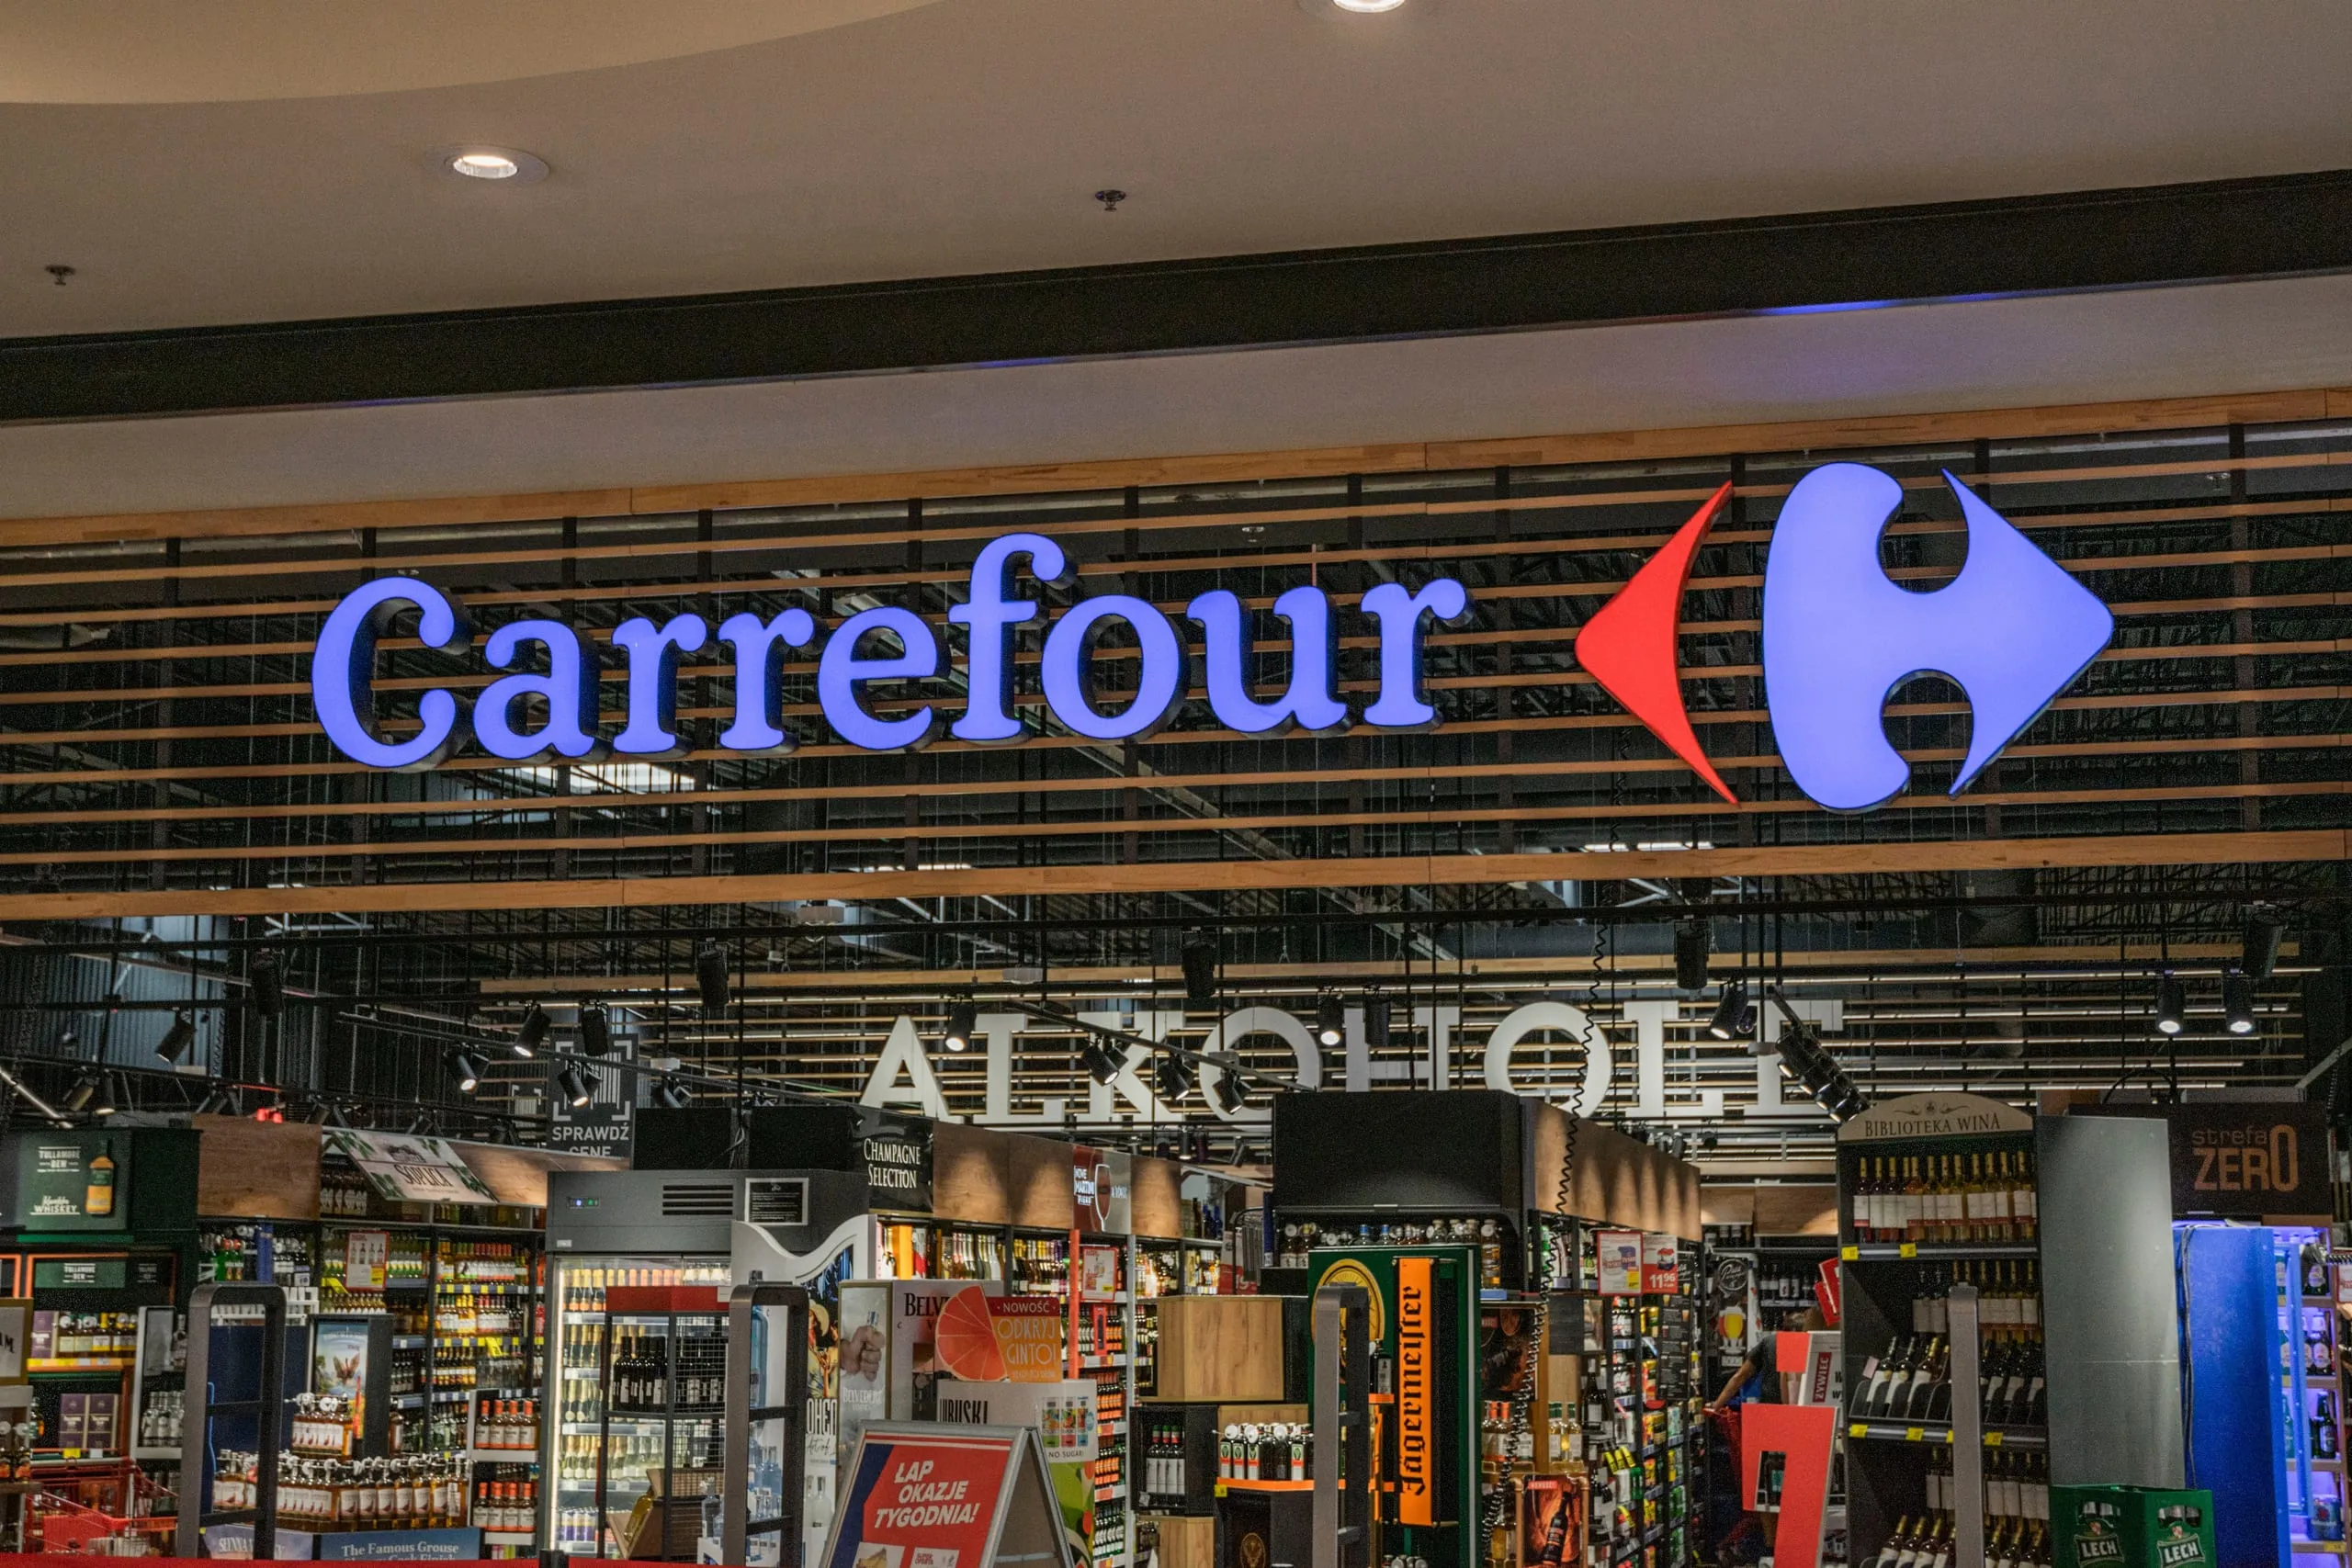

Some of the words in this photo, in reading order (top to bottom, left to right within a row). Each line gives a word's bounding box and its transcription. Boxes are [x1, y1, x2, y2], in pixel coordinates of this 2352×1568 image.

[311, 531, 1467, 768] Carrefour
[859, 1000, 1846, 1132] ALKOHOLE
[551, 1122, 629, 1141] SPRAWDŹ
[1865, 1119, 1952, 1137] BIBLIOTEKA
[1957, 1112, 2001, 1131] WINA
[2192, 1124, 2267, 1145] strefa
[864, 1137, 921, 1166] CHAMPAGNE
[2193, 1124, 2299, 1192] ZERO
[393, 1163, 454, 1188] SOPLICA
[867, 1163, 918, 1189] SELECTION
[34, 1204, 78, 1213] WHISKEY
[1003, 1300, 1050, 1314] NOWOŚĆ
[998, 1317, 1056, 1340] ODKRYJ
[1048, 1450, 1060, 1459] NO
[898, 1480, 969, 1505] OKAZJE
[874, 1503, 981, 1529] TYGODNIA!
[341, 1544, 366, 1557] The
[368, 1542, 414, 1555] Famous
[417, 1540, 459, 1553] Grouse
[2081, 1540, 2118, 1559] LECH
[2164, 1541, 2199, 1563] LECH
